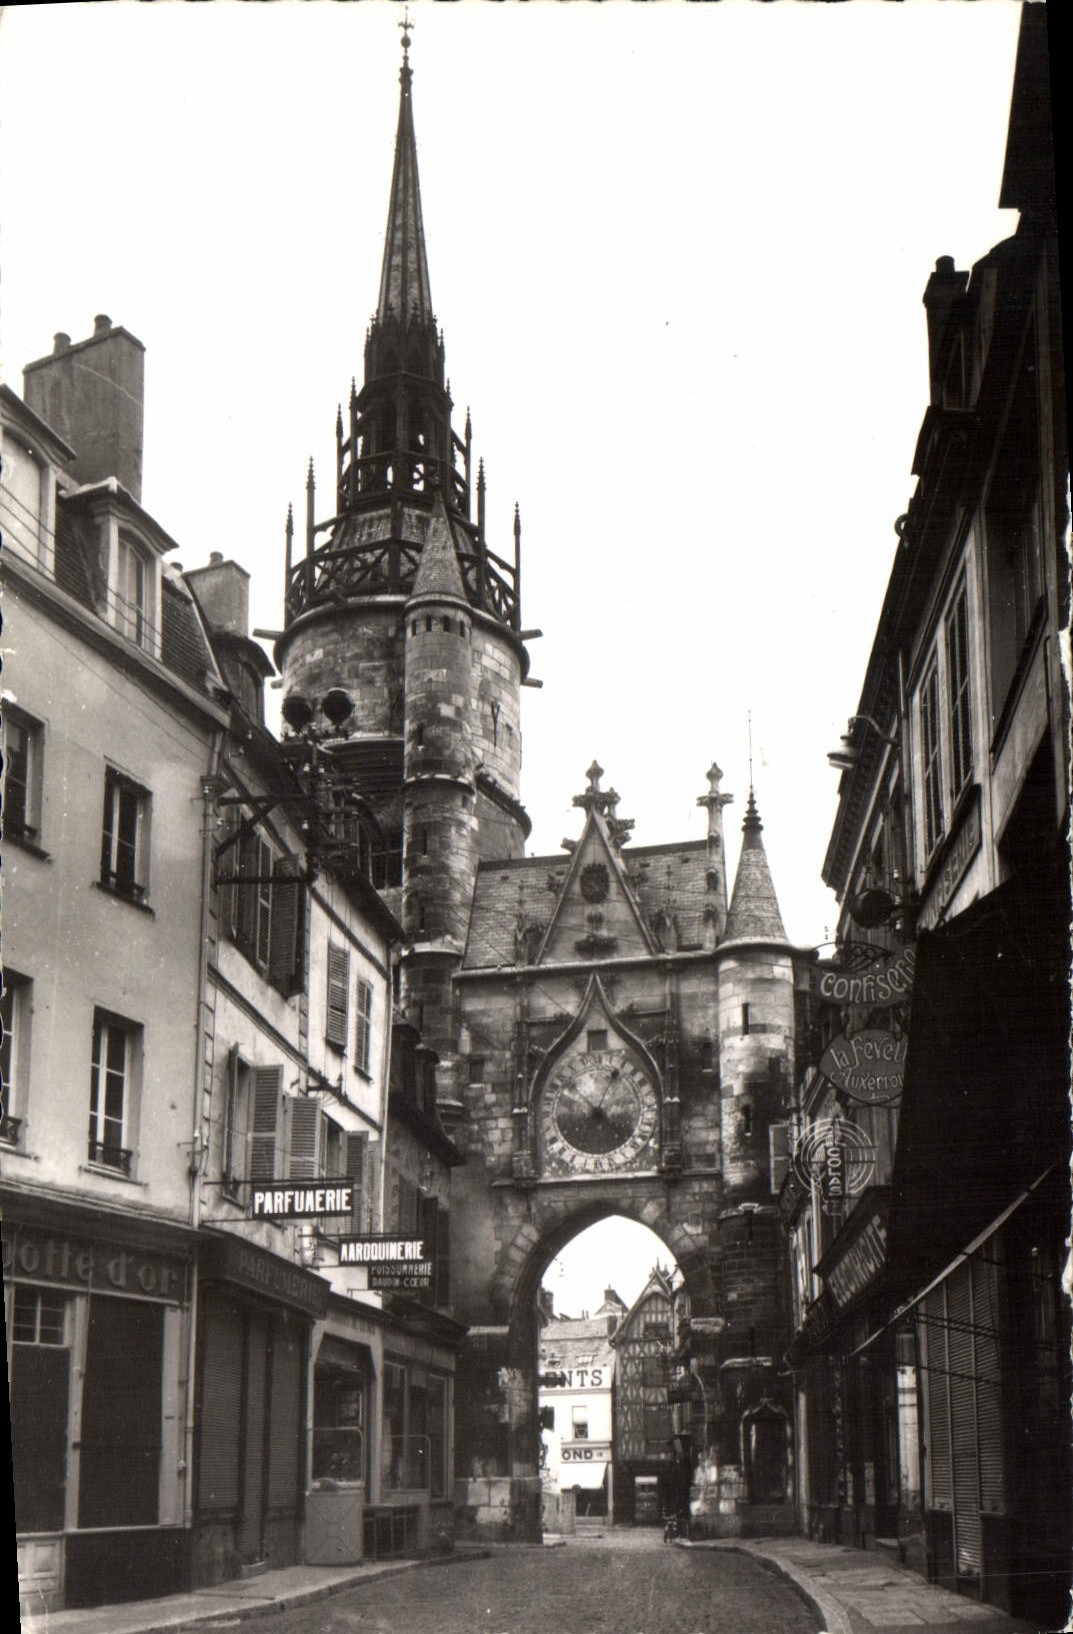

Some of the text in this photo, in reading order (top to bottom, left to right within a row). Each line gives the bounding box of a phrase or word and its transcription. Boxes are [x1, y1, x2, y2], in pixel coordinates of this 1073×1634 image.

[826, 1146, 843, 1197] COLAS
[254, 1188, 352, 1215] PARFUMERIE
[340, 1240, 425, 1262] MAROQUINERIE
[371, 1261, 433, 1277] POISSONNERIE
